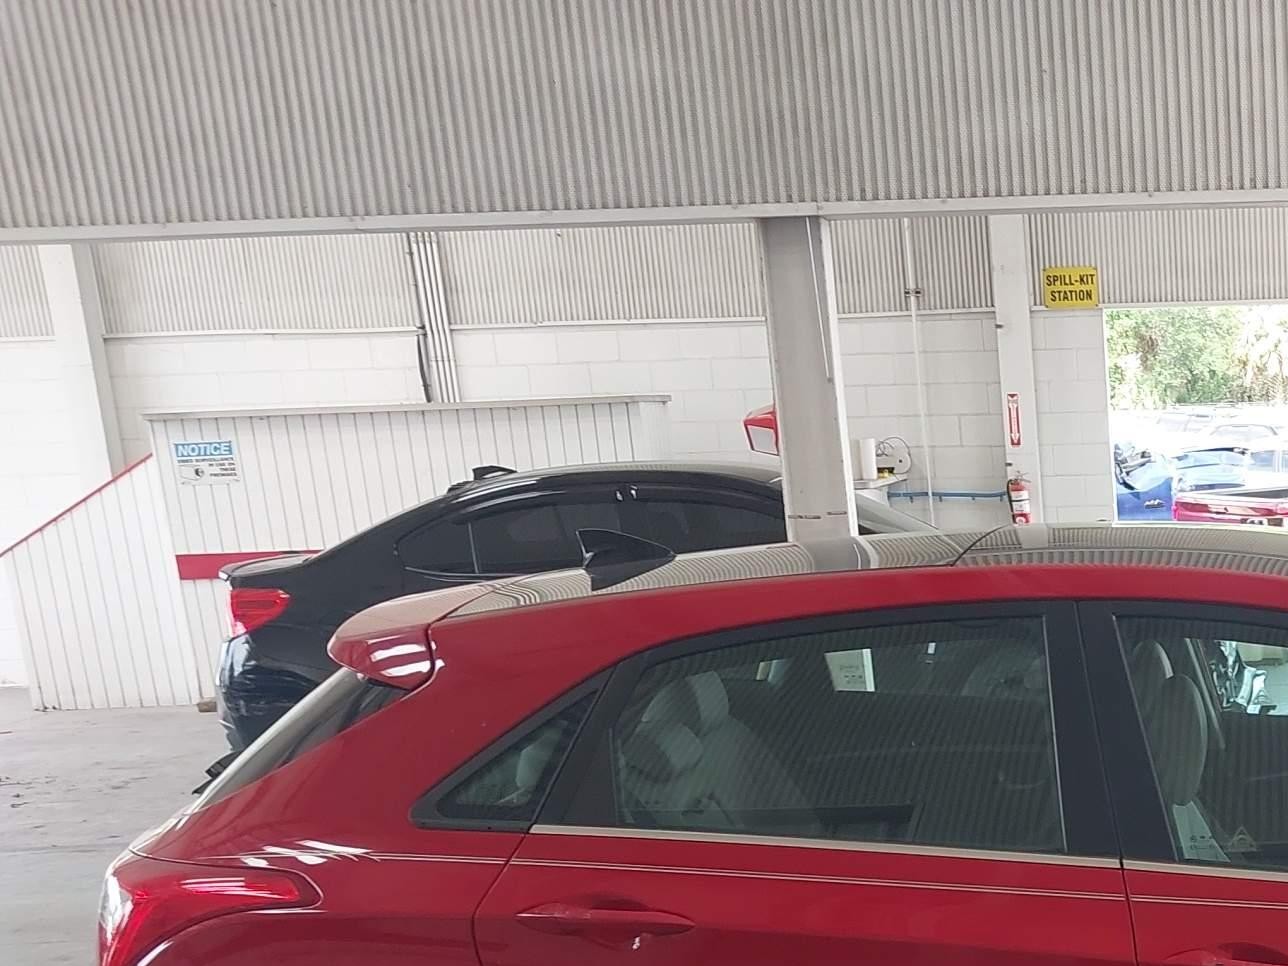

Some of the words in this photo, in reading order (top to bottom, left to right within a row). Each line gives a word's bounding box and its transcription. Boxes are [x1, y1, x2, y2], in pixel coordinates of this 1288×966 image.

[1046, 273, 1096, 287] SPILL-KIT
[1050, 289, 1093, 303] STATION
[177, 443, 230, 457] NOTICE
